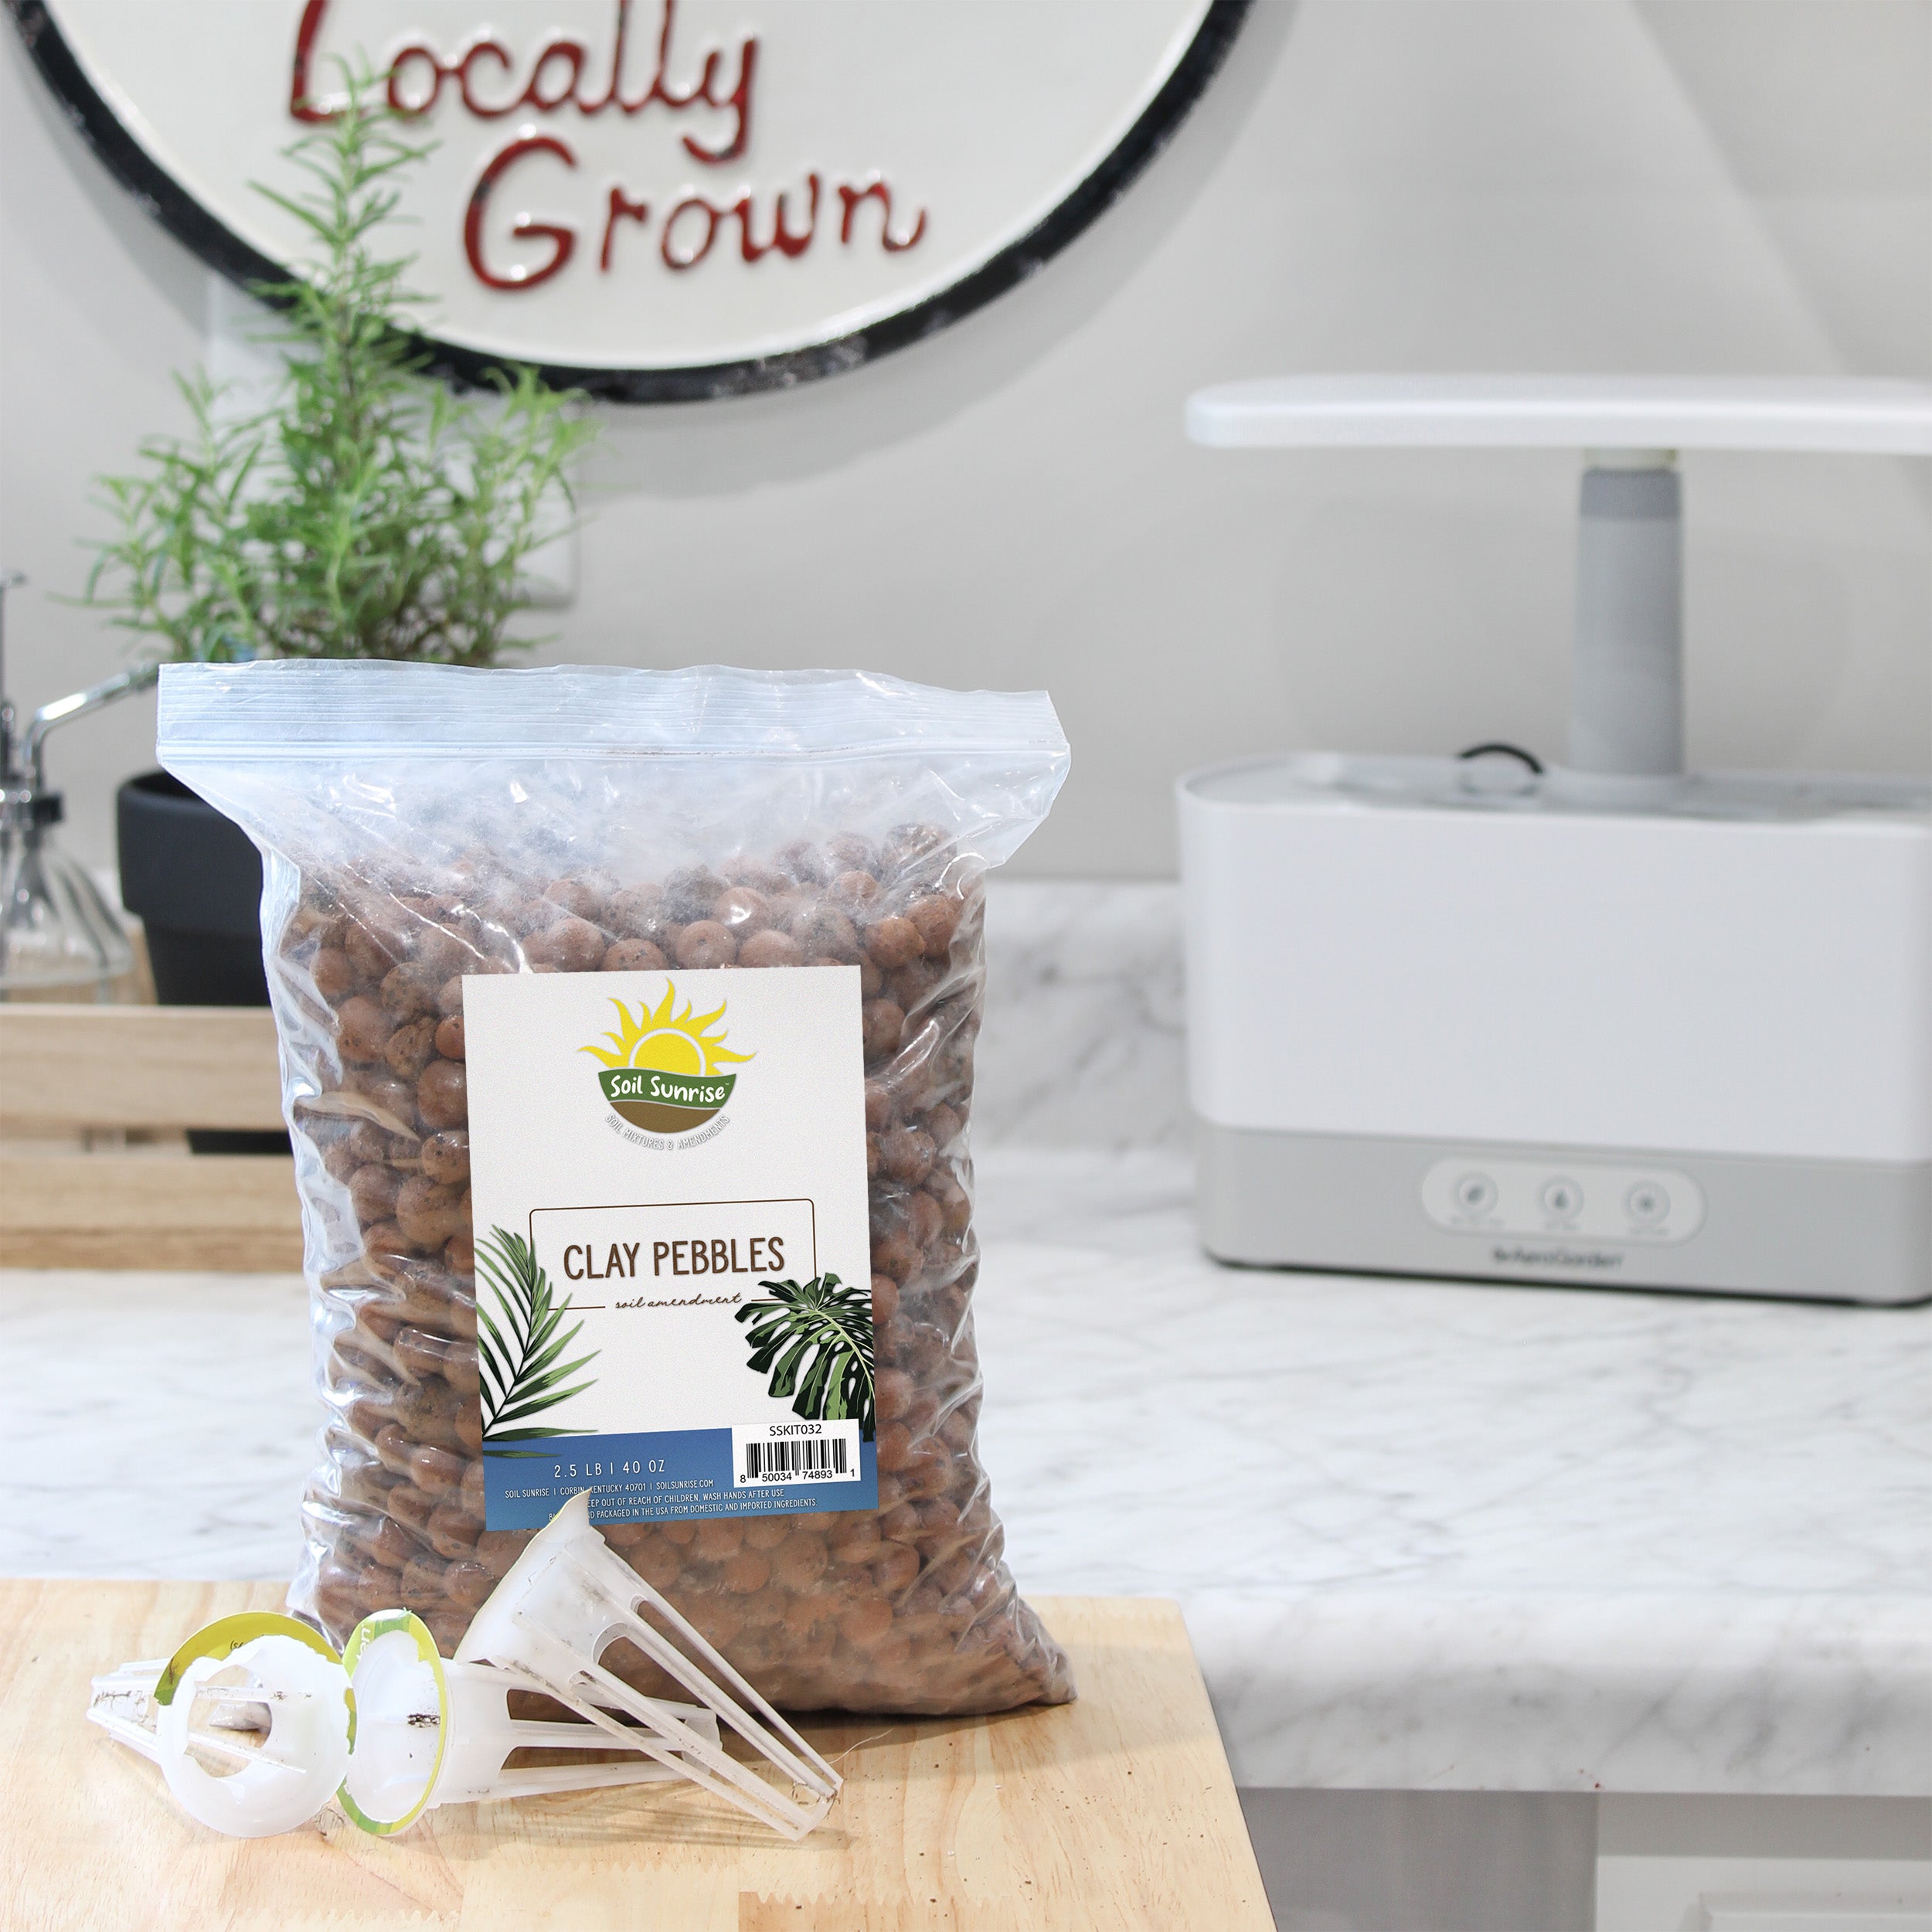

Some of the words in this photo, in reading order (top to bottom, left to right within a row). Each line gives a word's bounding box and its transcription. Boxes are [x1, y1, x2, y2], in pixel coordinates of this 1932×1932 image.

[291, 0, 757, 165] Locally
[464, 136, 926, 291] Grown
[611, 1075, 643, 1097] Soil
[606, 1114, 624, 1133] SOIL
[623, 1128, 664, 1150] MIXTURES
[678, 1114, 730, 1150] AMENDMENTS
[563, 1243, 640, 1280] CLAY
[653, 1236, 784, 1276] PEBBLES
[615, 1297, 645, 1308] soil
[648, 1292, 742, 1308] amendment
[769, 1423, 822, 1436] SSKIT032
[554, 1464, 577, 1478] 2.5
[586, 1463, 602, 1476] LB
[622, 1461, 641, 1474] 40
[648, 1459, 665, 1473] OZ
[740, 1475, 747, 1483] 8
[762, 1472, 792, 1482] 50034
[802, 1470, 833, 1480] 74893
[850, 1468, 855, 1477] 1
[505, 1490, 521, 1498] SOIL
[522, 1488, 550, 1498] SUNRISE
[625, 1483, 646, 1492] 40701
[656, 1479, 714, 1490] SOILSUNRISE.COM
[587, 1498, 600, 1507] EEP
[601, 1498, 615, 1507] OUT
[617, 1497, 626, 1505] OF
[629, 1496, 651, 1505] REACH
[653, 1495, 662, 1504] OF
[702, 1492, 721, 1501] WASH
[723, 1491, 747, 1500] HANDS
[748, 1490, 770, 1498] AFTER
[597, 1509, 631, 1519] PACKAGED
[641, 1507, 654, 1515] THE
[656, 1506, 669, 1515] USA
[671, 1505, 689, 1514] FROM
[690, 1503, 723, 1513] DOMESTIC
[740, 1501, 772, 1510] IMPORTED
